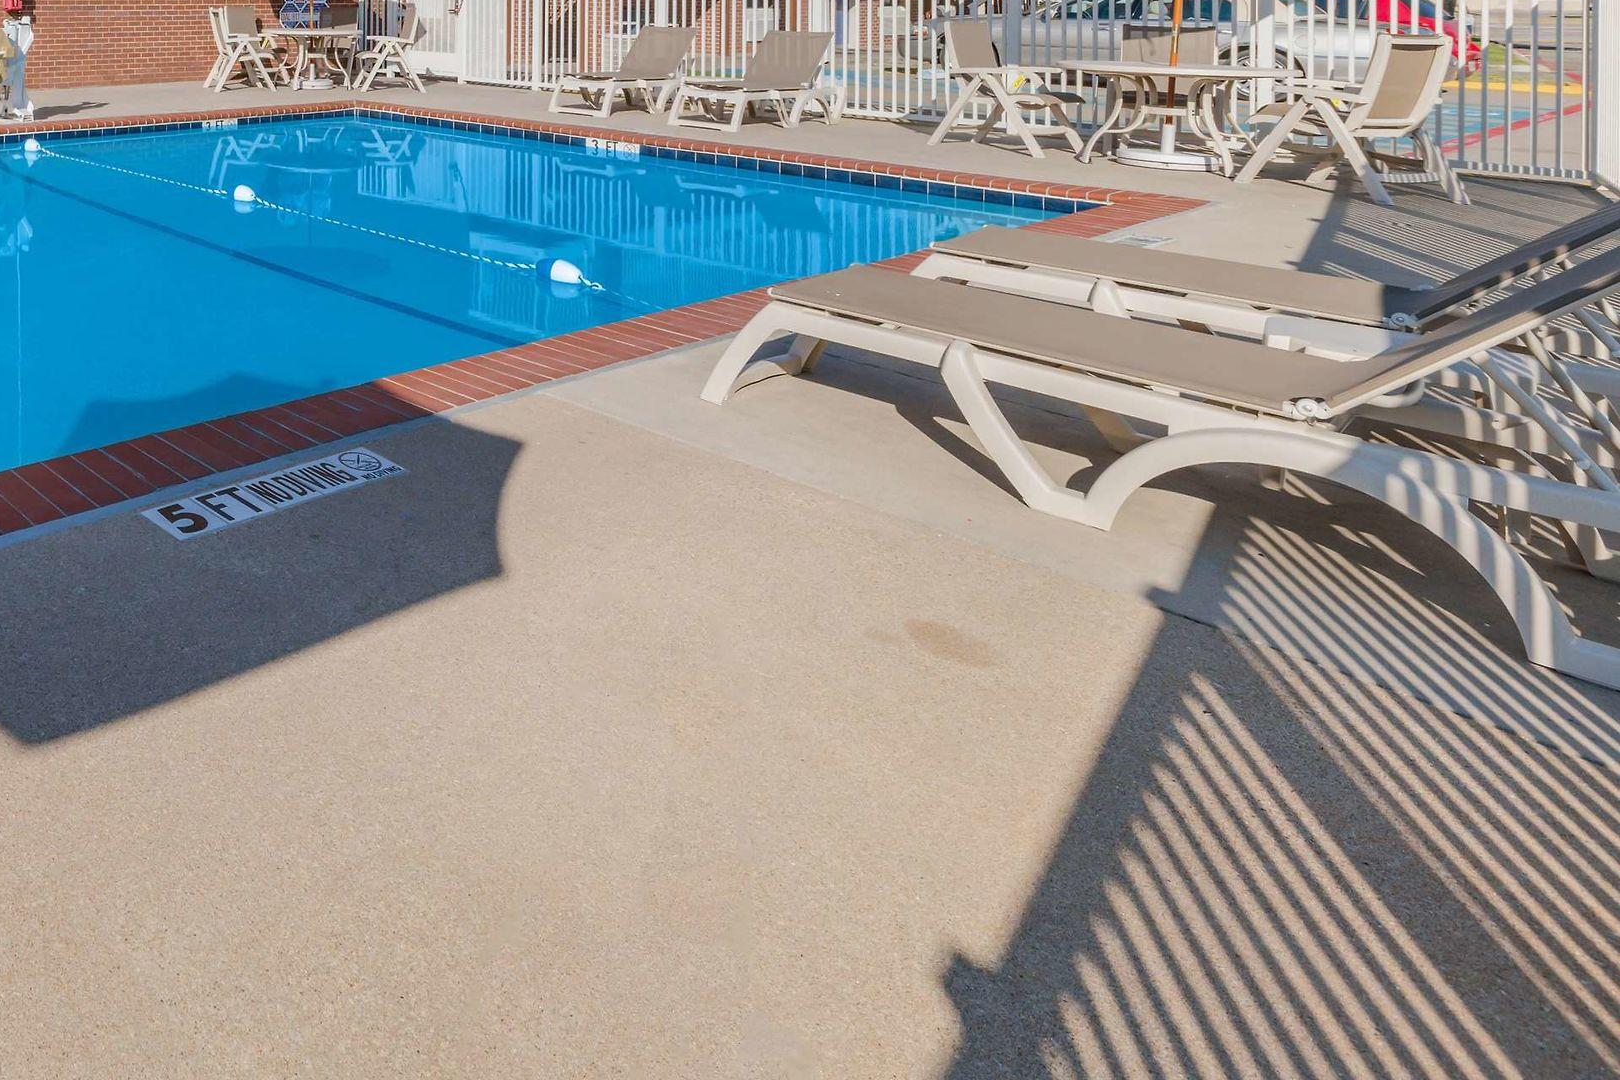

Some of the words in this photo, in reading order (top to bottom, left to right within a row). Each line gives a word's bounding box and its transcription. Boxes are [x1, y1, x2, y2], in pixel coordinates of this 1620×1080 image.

[591, 139, 599, 153] 3
[605, 140, 619, 156] FT
[157, 503, 208, 534] 5
[195, 486, 263, 521] FT
